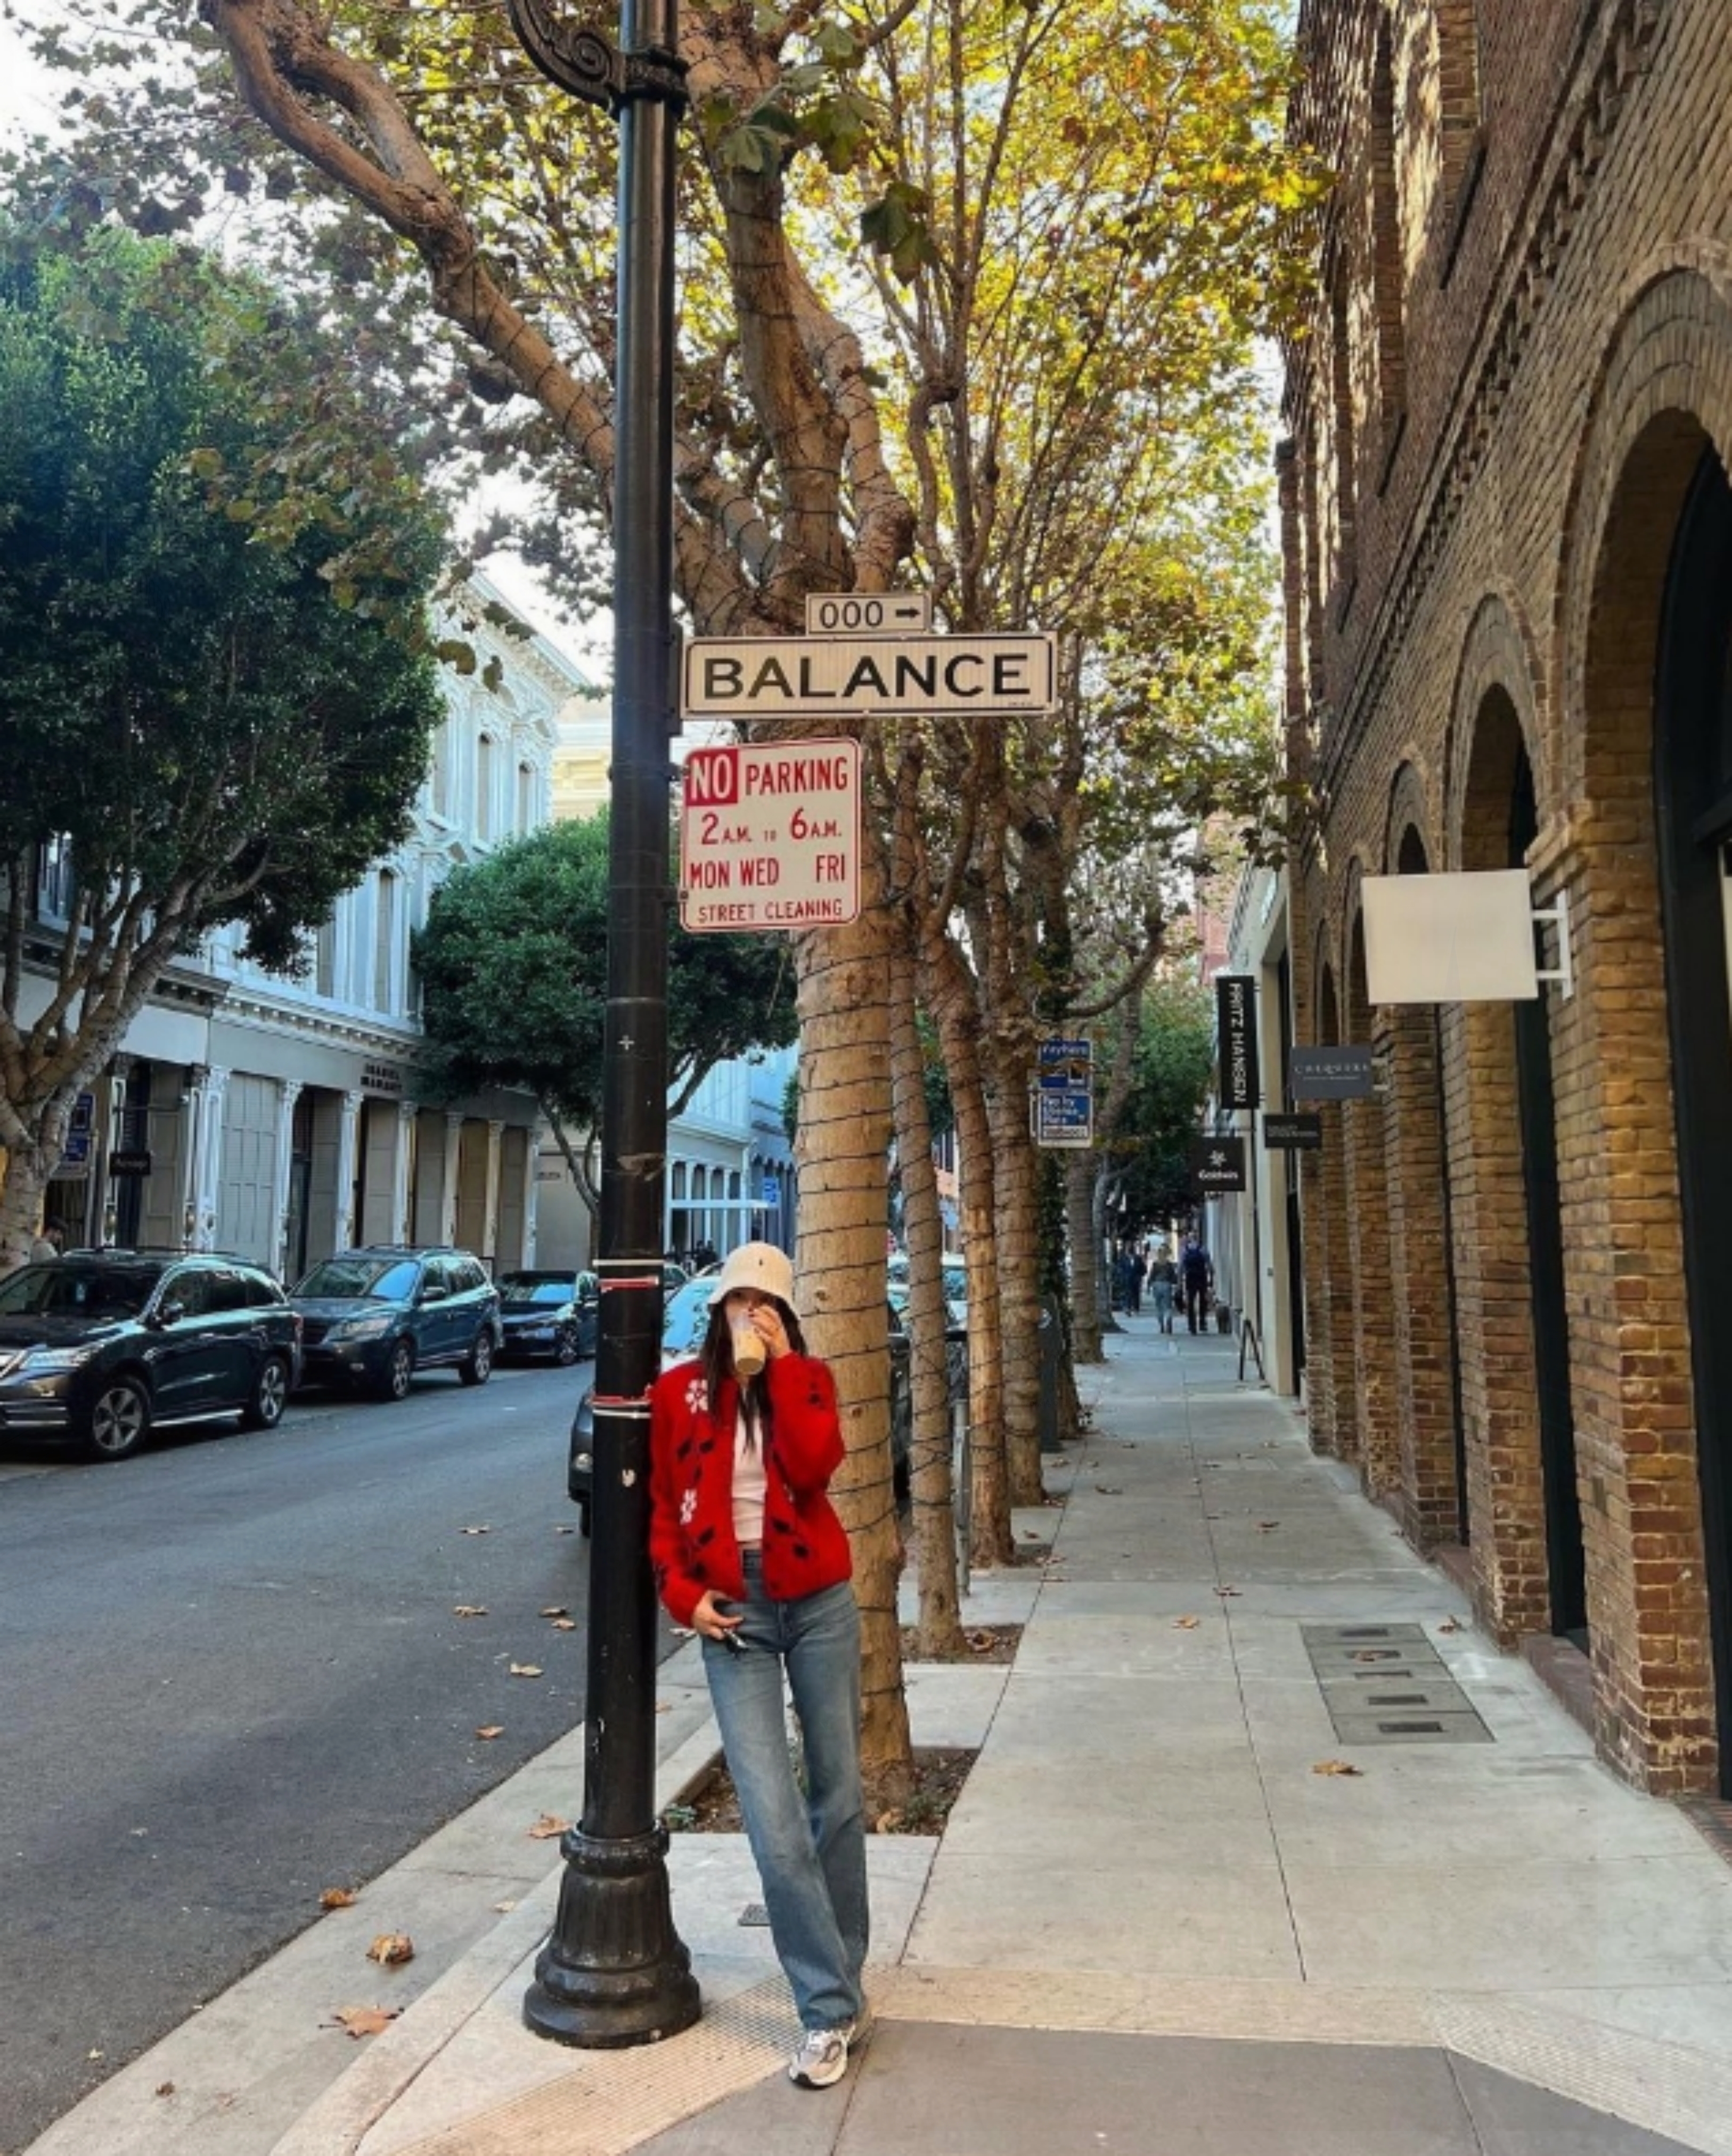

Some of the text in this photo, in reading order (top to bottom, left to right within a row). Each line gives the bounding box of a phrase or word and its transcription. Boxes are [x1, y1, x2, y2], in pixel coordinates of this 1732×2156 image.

[819, 601, 884, 629] 000
[704, 653, 1031, 699] BALANCE
[692, 753, 848, 800] NO PARKING
[690, 853, 846, 889] MON WED FRI
[698, 898, 843, 923] STREET CLEANING
[1231, 1032, 1246, 1103] HANSEN
